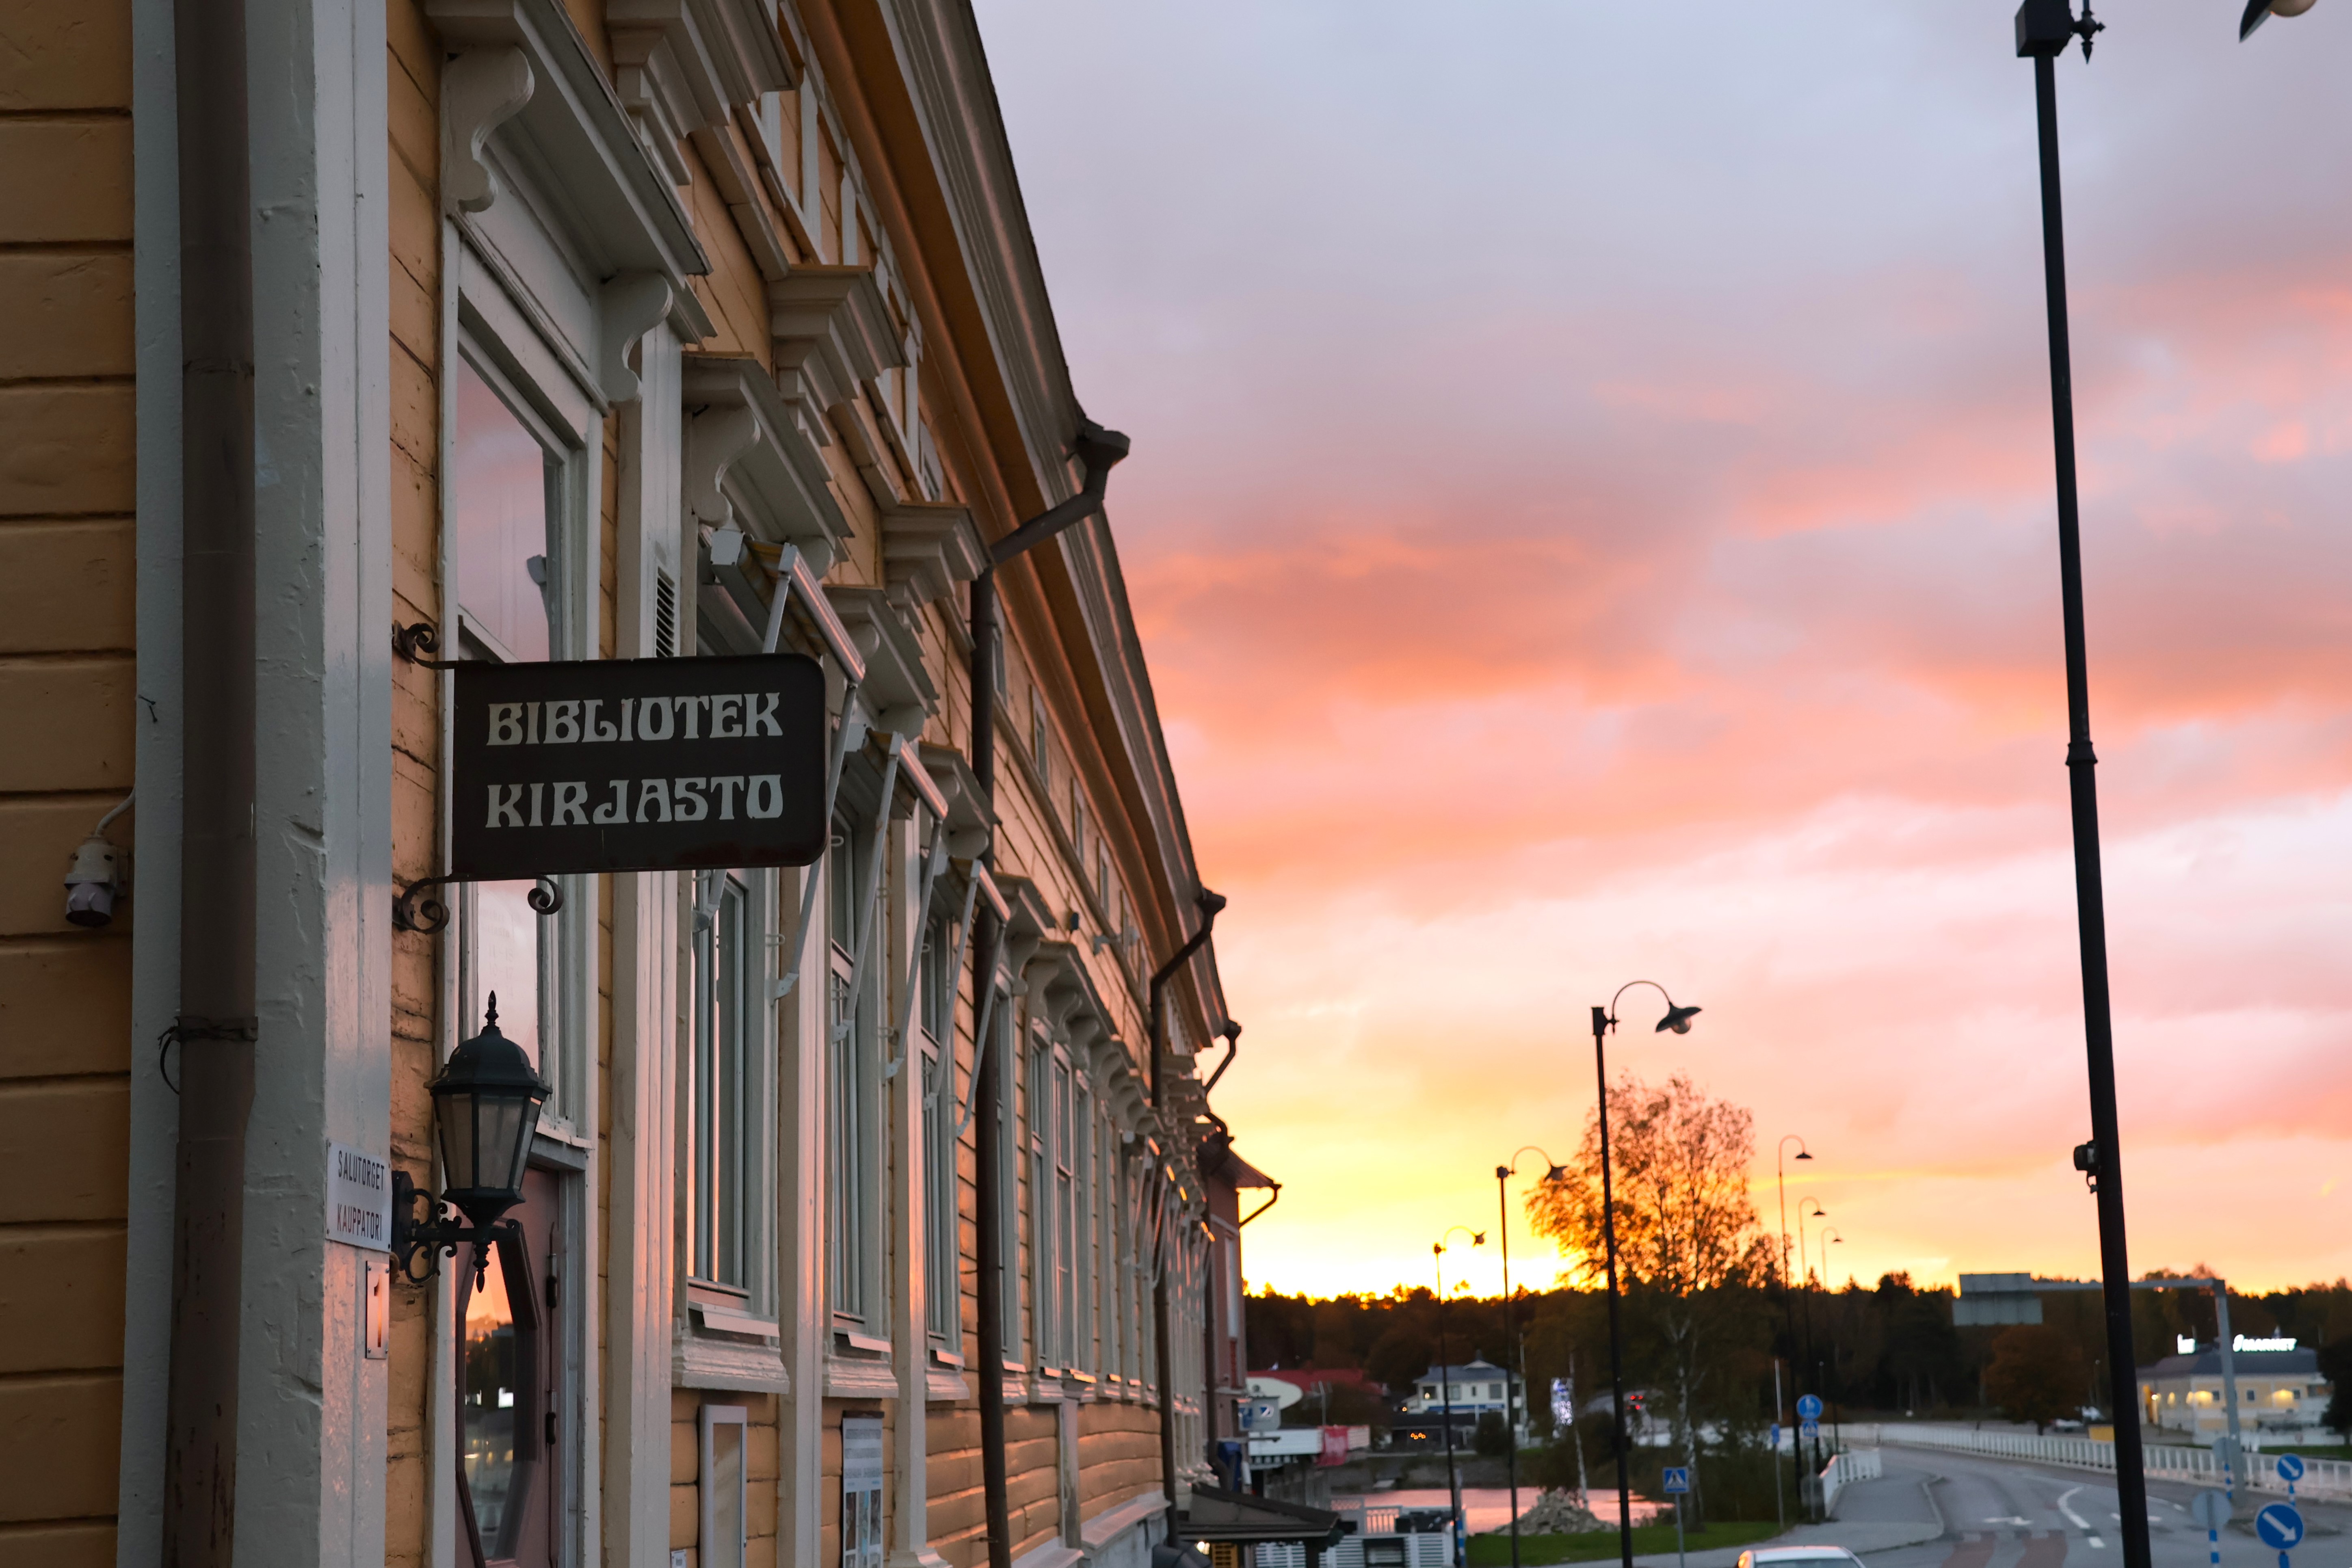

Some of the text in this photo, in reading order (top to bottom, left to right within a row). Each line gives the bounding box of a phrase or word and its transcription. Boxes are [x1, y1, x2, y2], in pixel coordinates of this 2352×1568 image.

[487, 692, 783, 746] BIBLIOTEK
[486, 774, 783, 828] KIRJASTO
[338, 1150, 385, 1191] SALUTORGET
[337, 1202, 382, 1241] KAUPPATORI
[373, 1274, 383, 1348] 1
